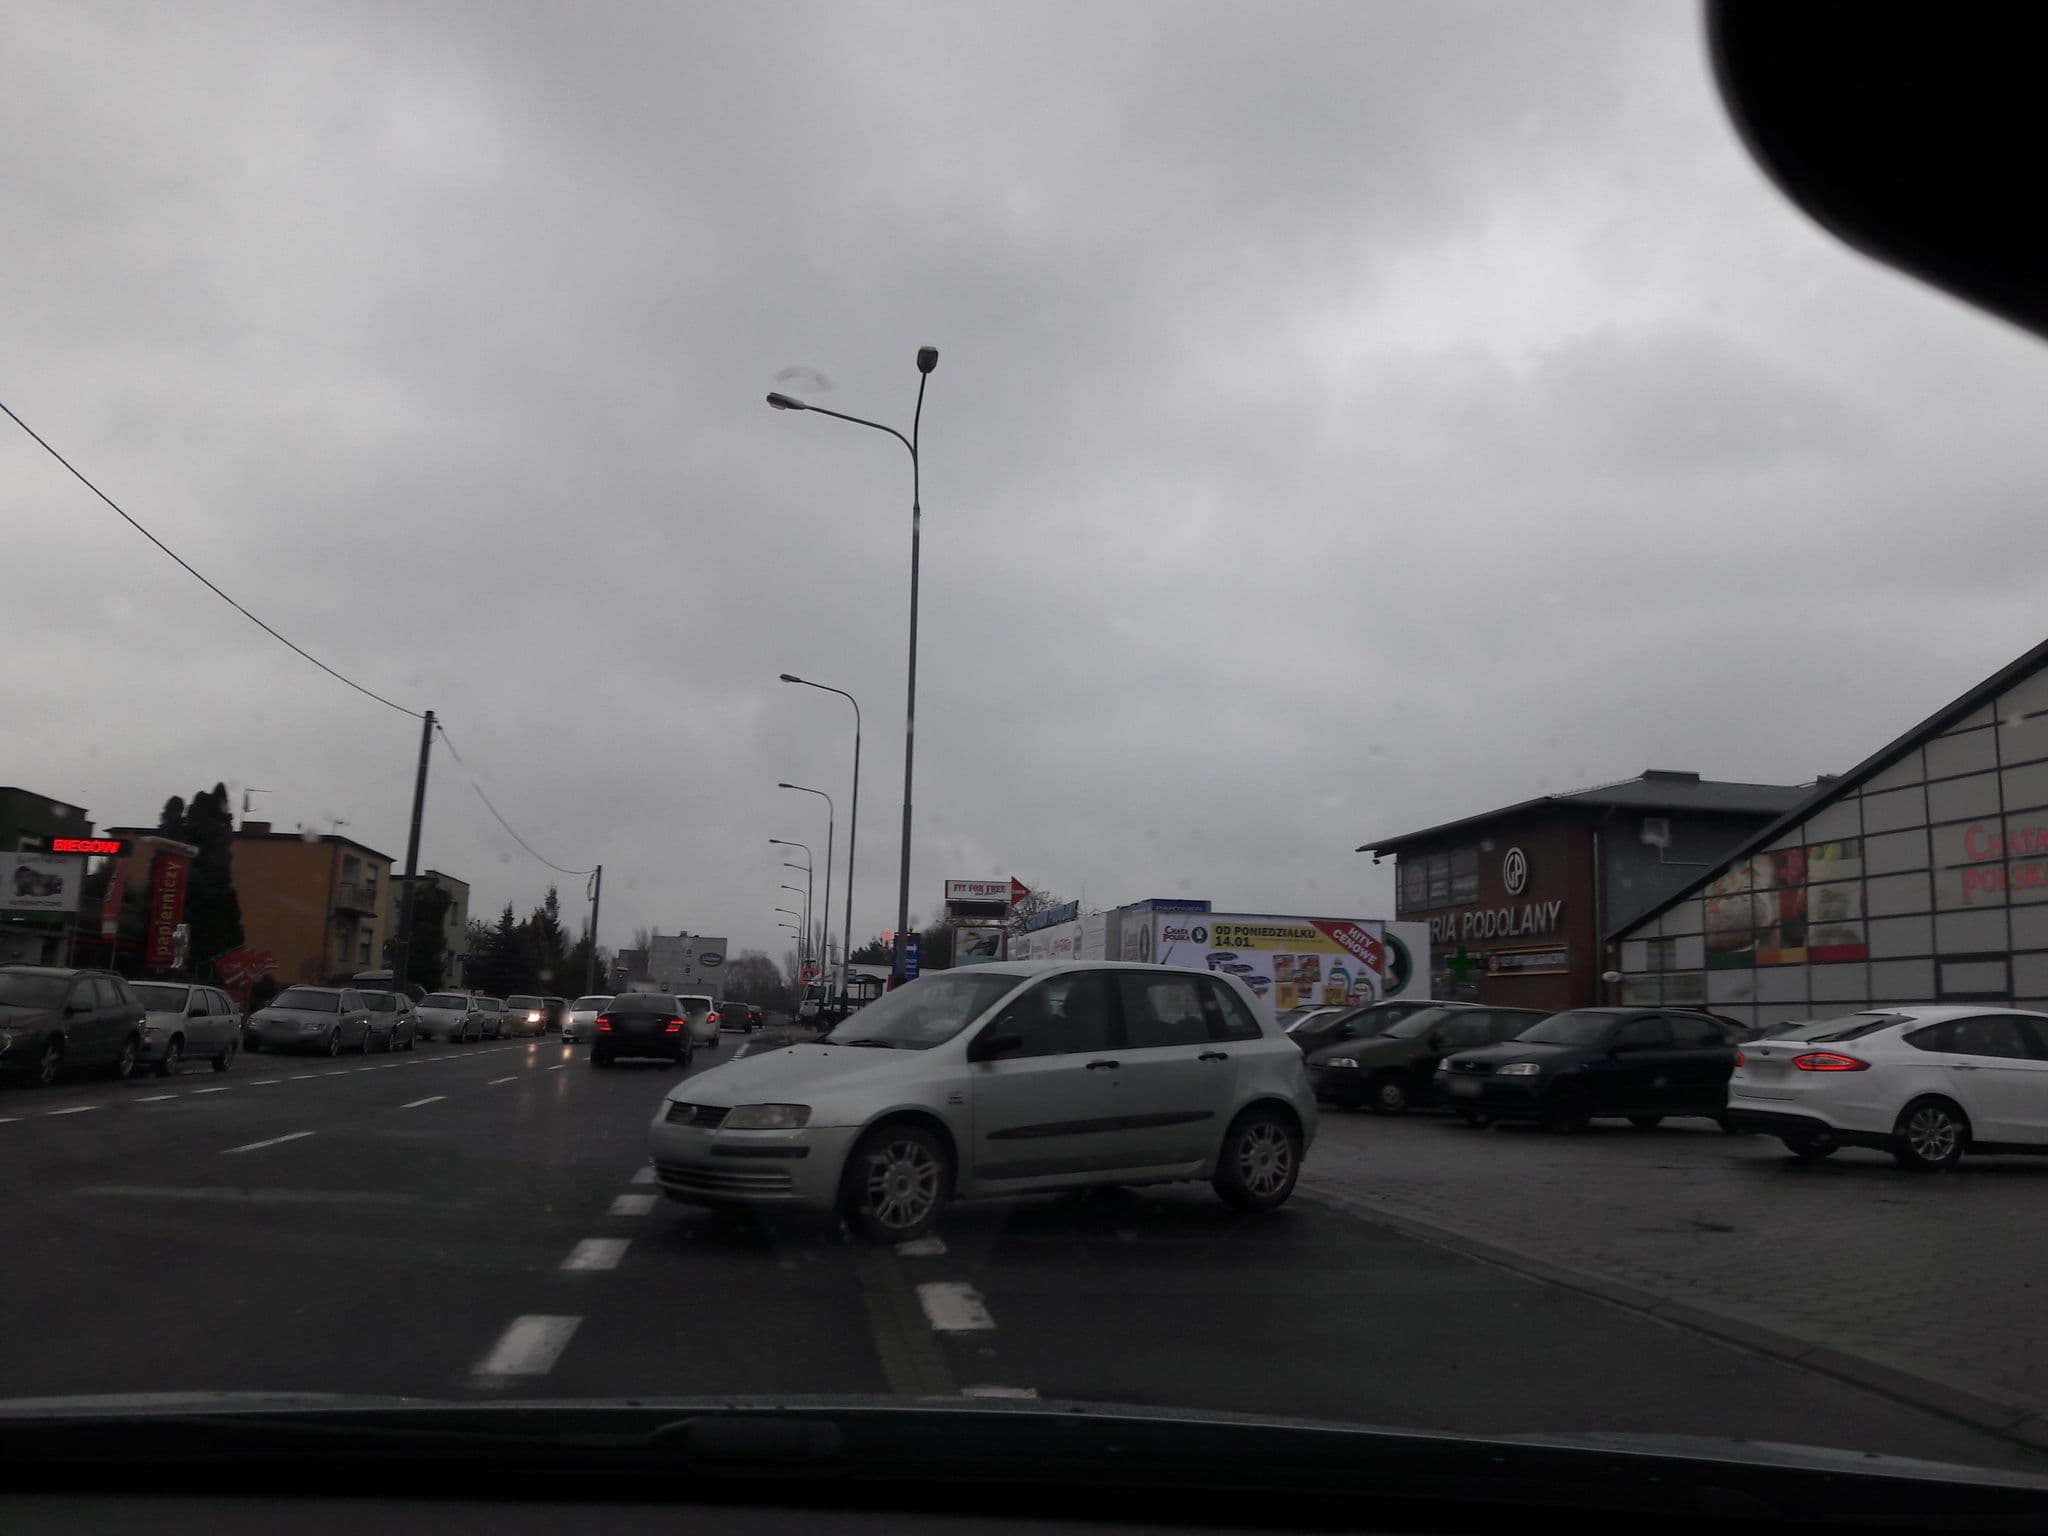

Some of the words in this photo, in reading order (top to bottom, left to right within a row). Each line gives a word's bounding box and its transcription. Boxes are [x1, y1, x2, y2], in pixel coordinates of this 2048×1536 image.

[155, 860, 184, 956] papierniczy
[1462, 900, 1562, 942] PODOLANY
[1215, 926, 1231, 935] OD
[1215, 936, 1255, 948] 14.01.
[1347, 927, 1374, 947] HITY
[1332, 929, 1378, 965] CENOWE
